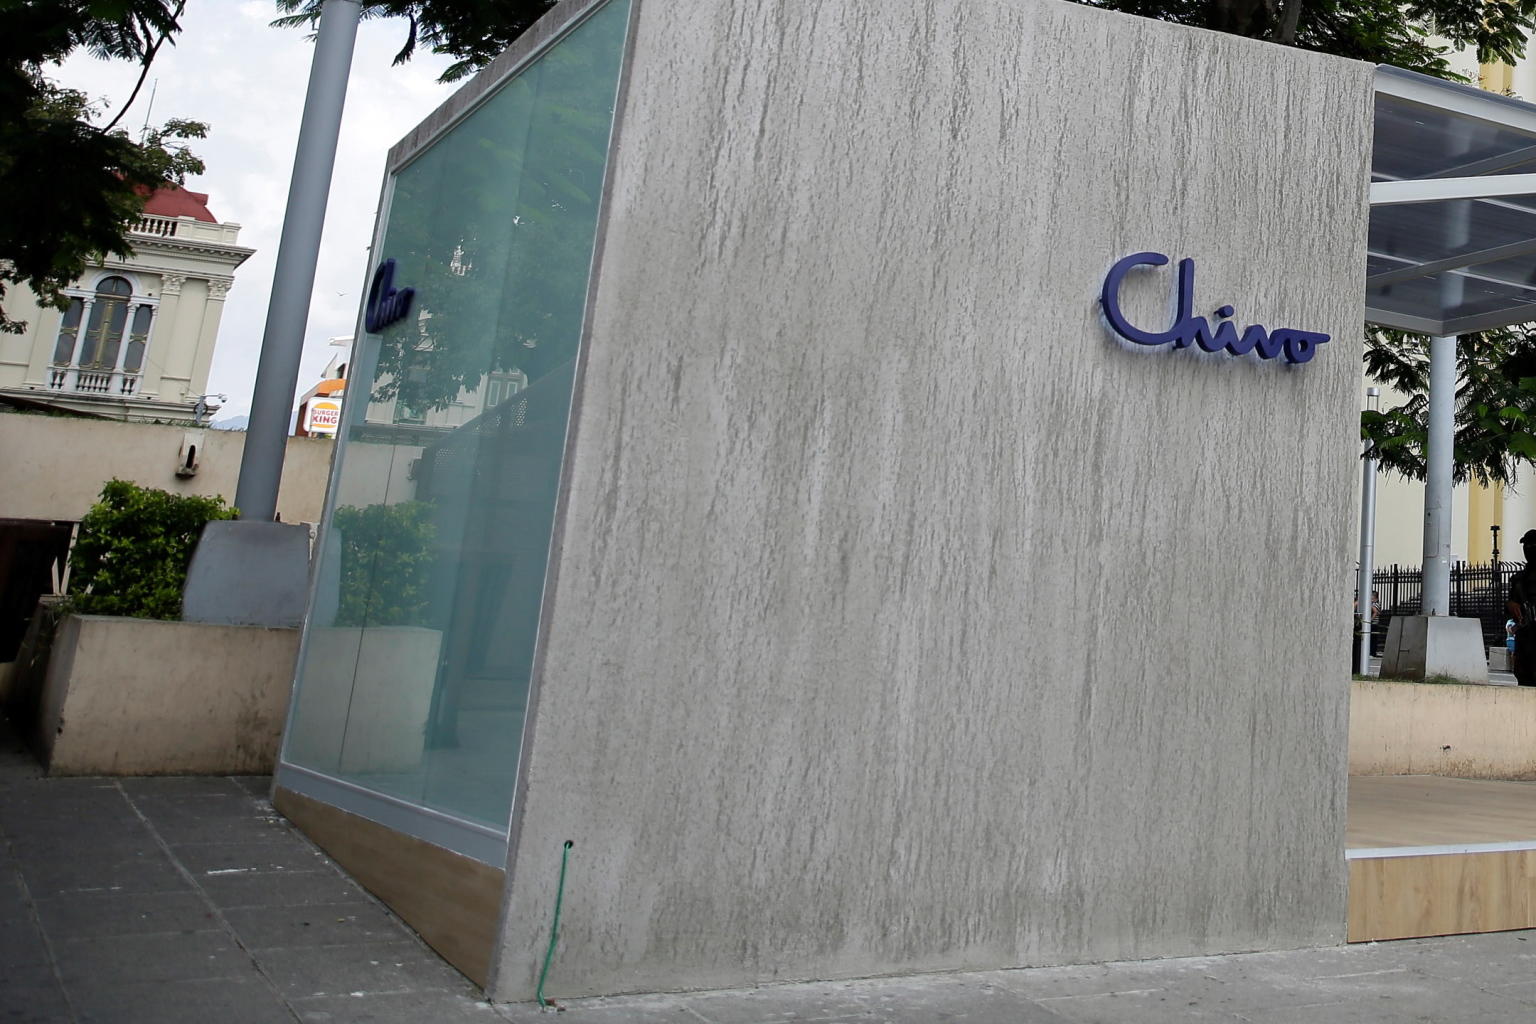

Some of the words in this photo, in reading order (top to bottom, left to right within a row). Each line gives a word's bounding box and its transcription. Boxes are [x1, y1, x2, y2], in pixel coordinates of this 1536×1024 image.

[1100, 251, 1331, 364] Chivo
[312, 408, 339, 416] BURGER
[311, 415, 338, 425] KING
